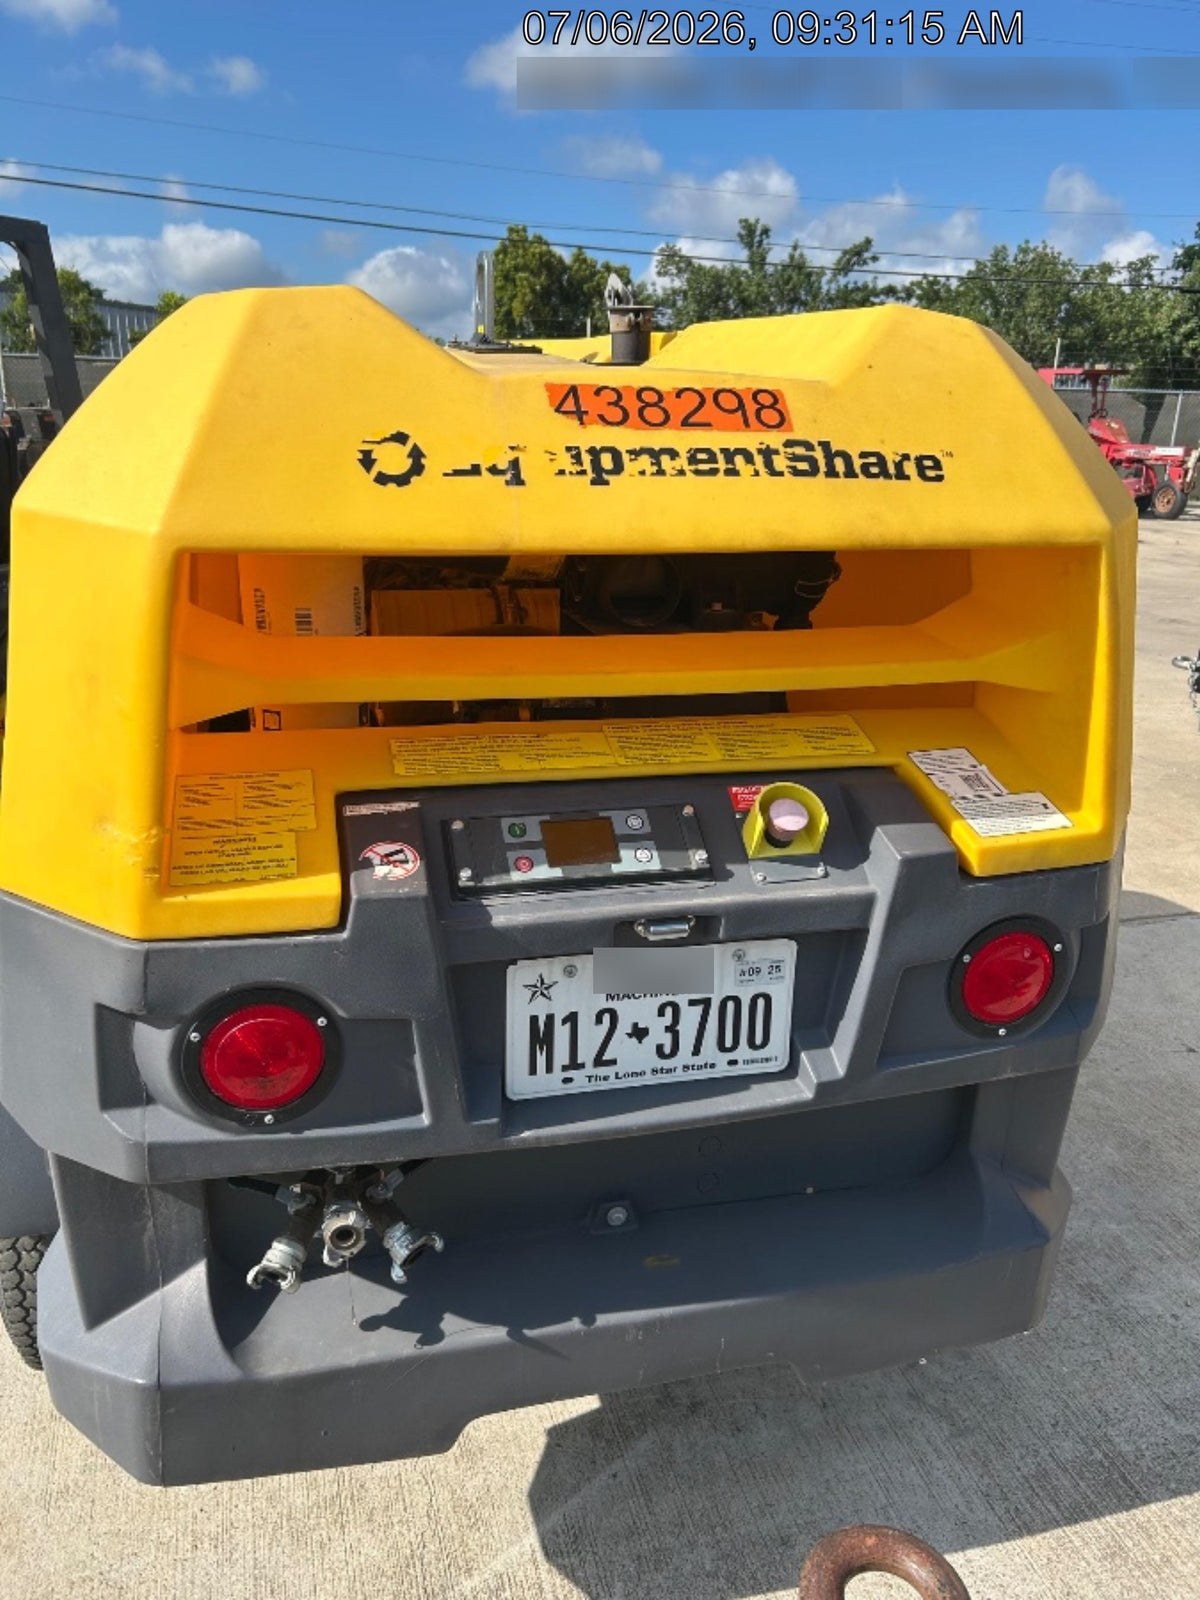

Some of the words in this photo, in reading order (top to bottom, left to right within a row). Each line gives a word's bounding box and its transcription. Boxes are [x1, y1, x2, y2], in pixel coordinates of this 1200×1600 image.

[553, 385, 787, 430] 438298
[528, 1006, 620, 1077] M12
[654, 991, 773, 1061] 3700
[585, 1073, 611, 1084] The
[614, 1068, 647, 1081] Lone
[650, 1064, 678, 1076] Star
[681, 1060, 717, 1073] State
